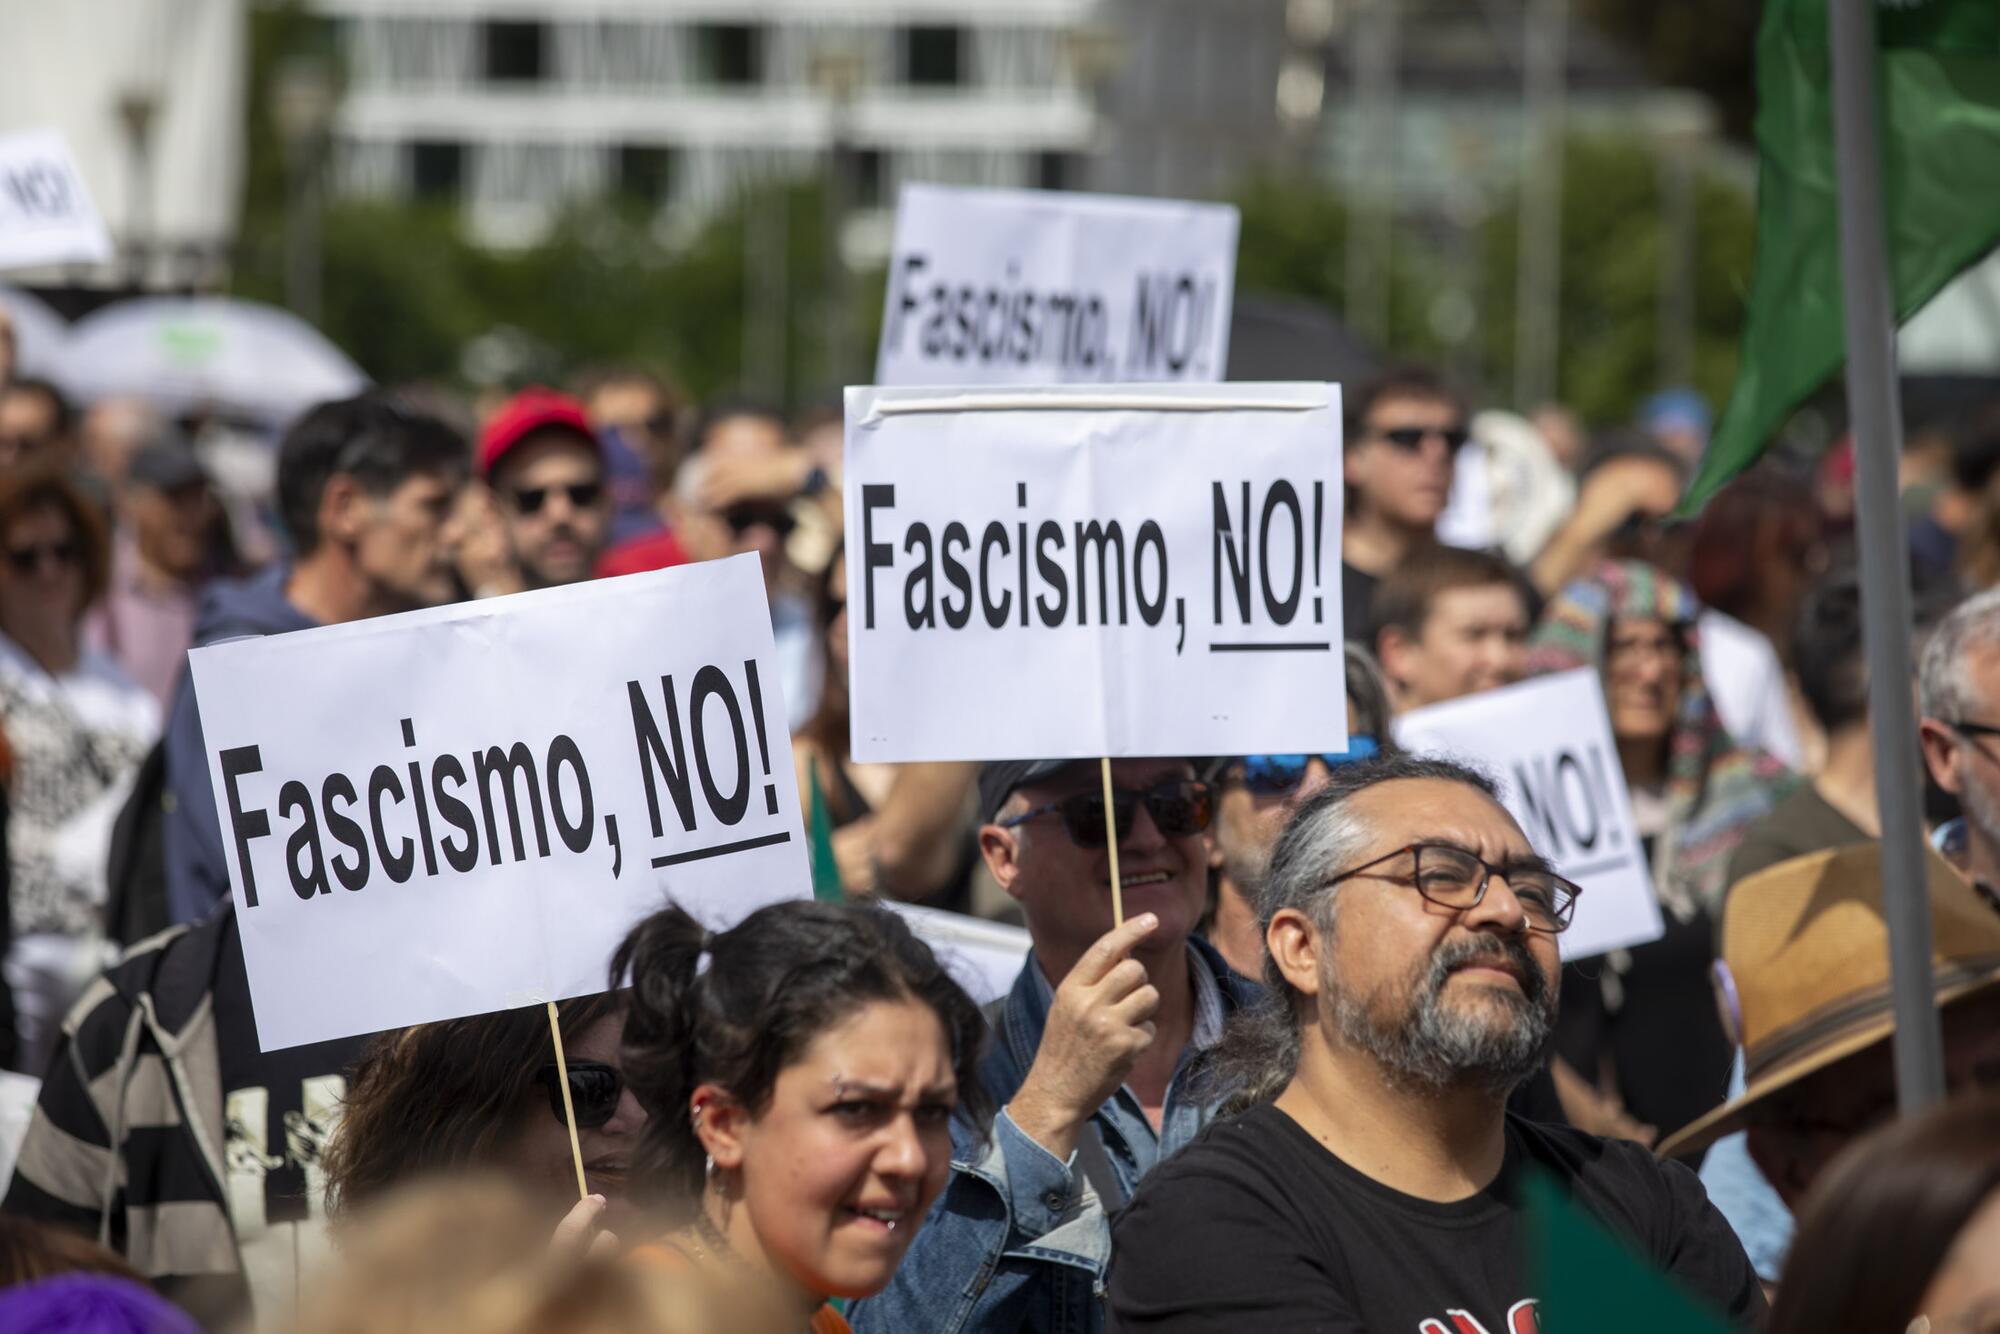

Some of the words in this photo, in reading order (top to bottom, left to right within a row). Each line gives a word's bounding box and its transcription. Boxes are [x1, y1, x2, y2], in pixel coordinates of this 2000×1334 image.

[886, 253, 1114, 378] Fascismo,
[1124, 268, 1216, 378] NO!
[862, 482, 1186, 656] Fascismo,
[1209, 479, 1324, 628] NO!
[218, 717, 623, 909] Fascismo,
[626, 658, 780, 840] NO!
[1511, 743, 1622, 858] NO!
